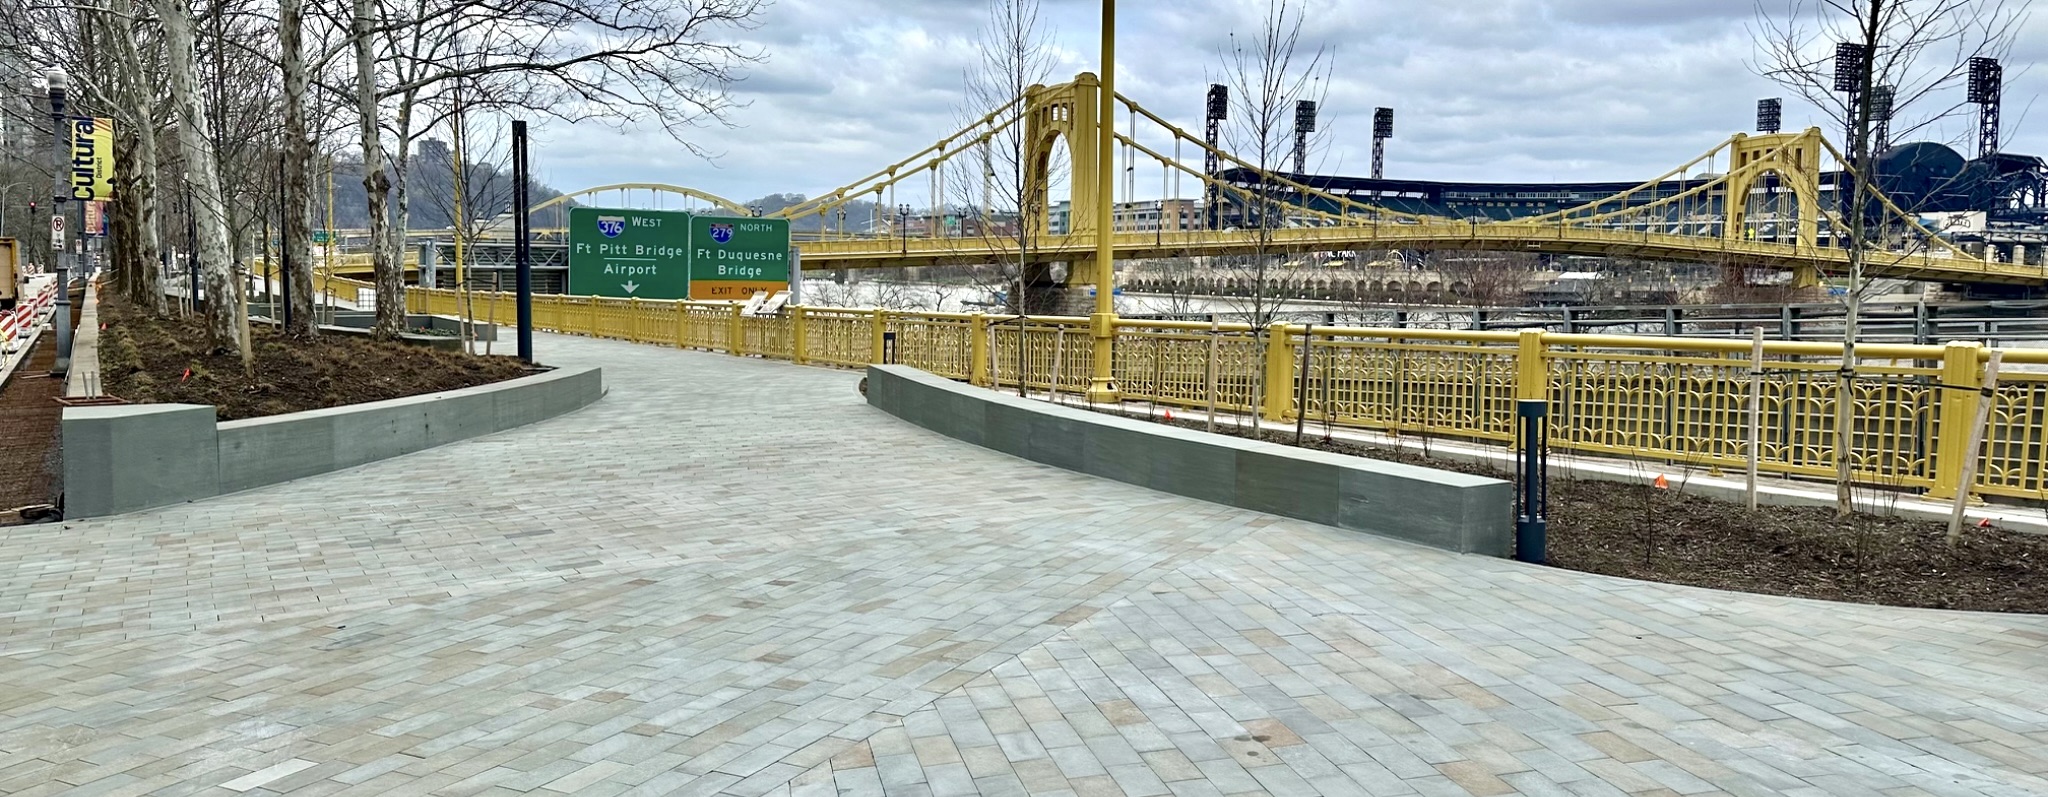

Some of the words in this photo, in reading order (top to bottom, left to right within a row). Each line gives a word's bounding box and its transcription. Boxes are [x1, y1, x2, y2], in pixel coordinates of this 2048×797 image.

[72, 117, 95, 200] Cultural
[599, 220, 623, 234] 376
[631, 216, 662, 228] WEST
[712, 227, 733, 238] 279
[740, 223, 773, 232] NORTH
[576, 243, 591, 254] Ft
[600, 243, 627, 255] Pitt
[635, 244, 683, 259] Bridge
[697, 248, 711, 259] Ft
[718, 250, 783, 262] Duquesne
[604, 264, 657, 276] Airport
[718, 265, 762, 278] Bridge
[711, 286, 733, 295] EXIT
